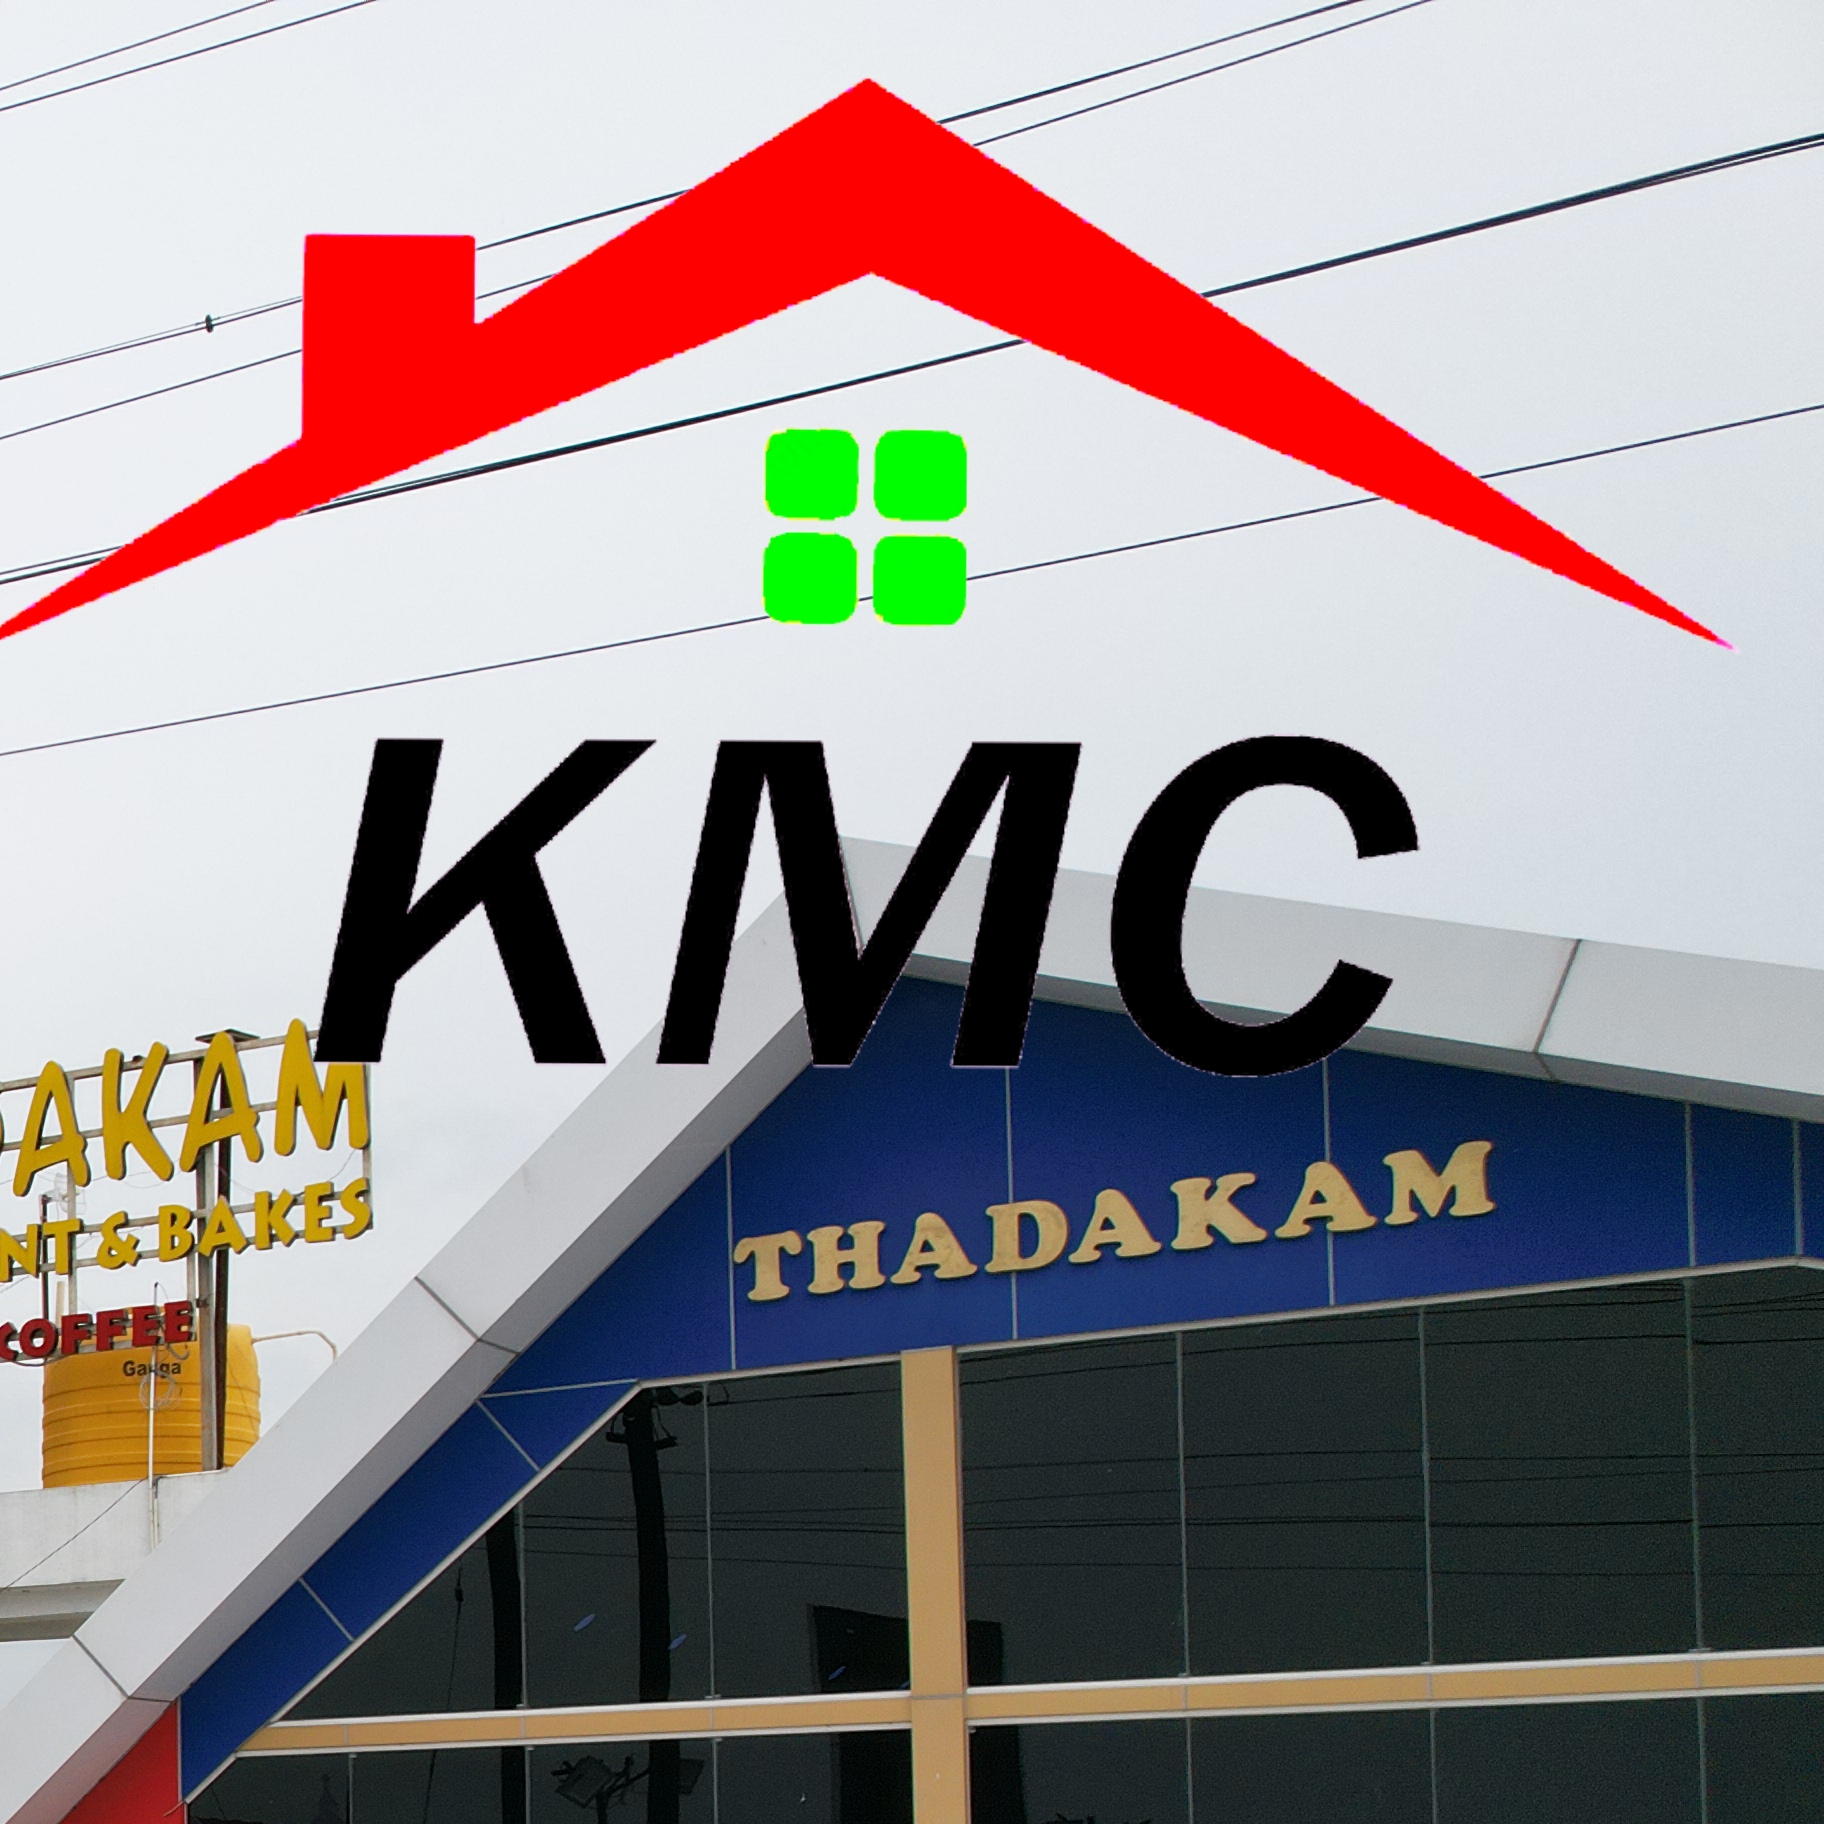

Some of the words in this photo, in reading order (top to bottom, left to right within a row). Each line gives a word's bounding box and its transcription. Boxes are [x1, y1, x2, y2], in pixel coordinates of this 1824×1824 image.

[96, 1210, 141, 1269] &
[157, 1176, 373, 1262] BAKES
[734, 1140, 1495, 1301] THADAKAM
